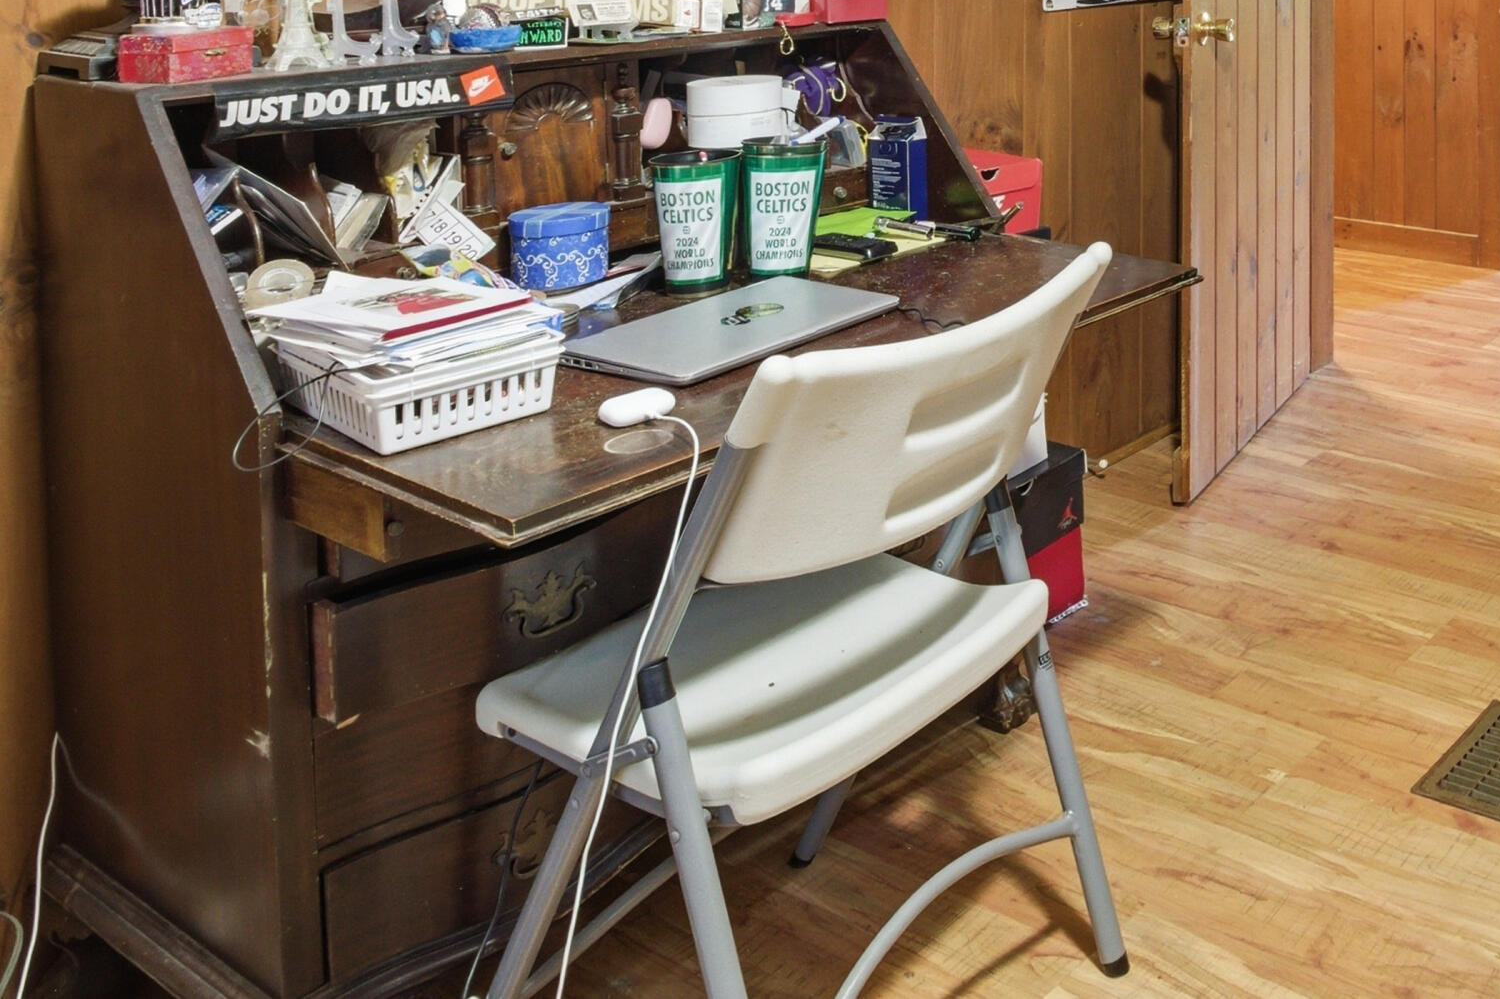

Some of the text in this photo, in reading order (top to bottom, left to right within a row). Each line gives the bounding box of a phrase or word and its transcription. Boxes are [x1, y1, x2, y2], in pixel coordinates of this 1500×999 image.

[219, 78, 460, 128] JUST DO IT, USA.
[755, 181, 810, 197] BOSTON
[660, 189, 715, 207] BOSTON
[756, 198, 807, 214] CELTICS
[662, 207, 714, 224] CELTICS
[430, 218, 448, 234] 18
[443, 231, 462, 246] 19
[768, 227, 792, 237] 2024
[675, 237, 699, 246] 2024
[765, 238, 797, 249] WORLD
[674, 248, 706, 259] WORLD
[755, 248, 804, 261] CHAMPIONS
[666, 257, 714, 270] CHAMPIONS
